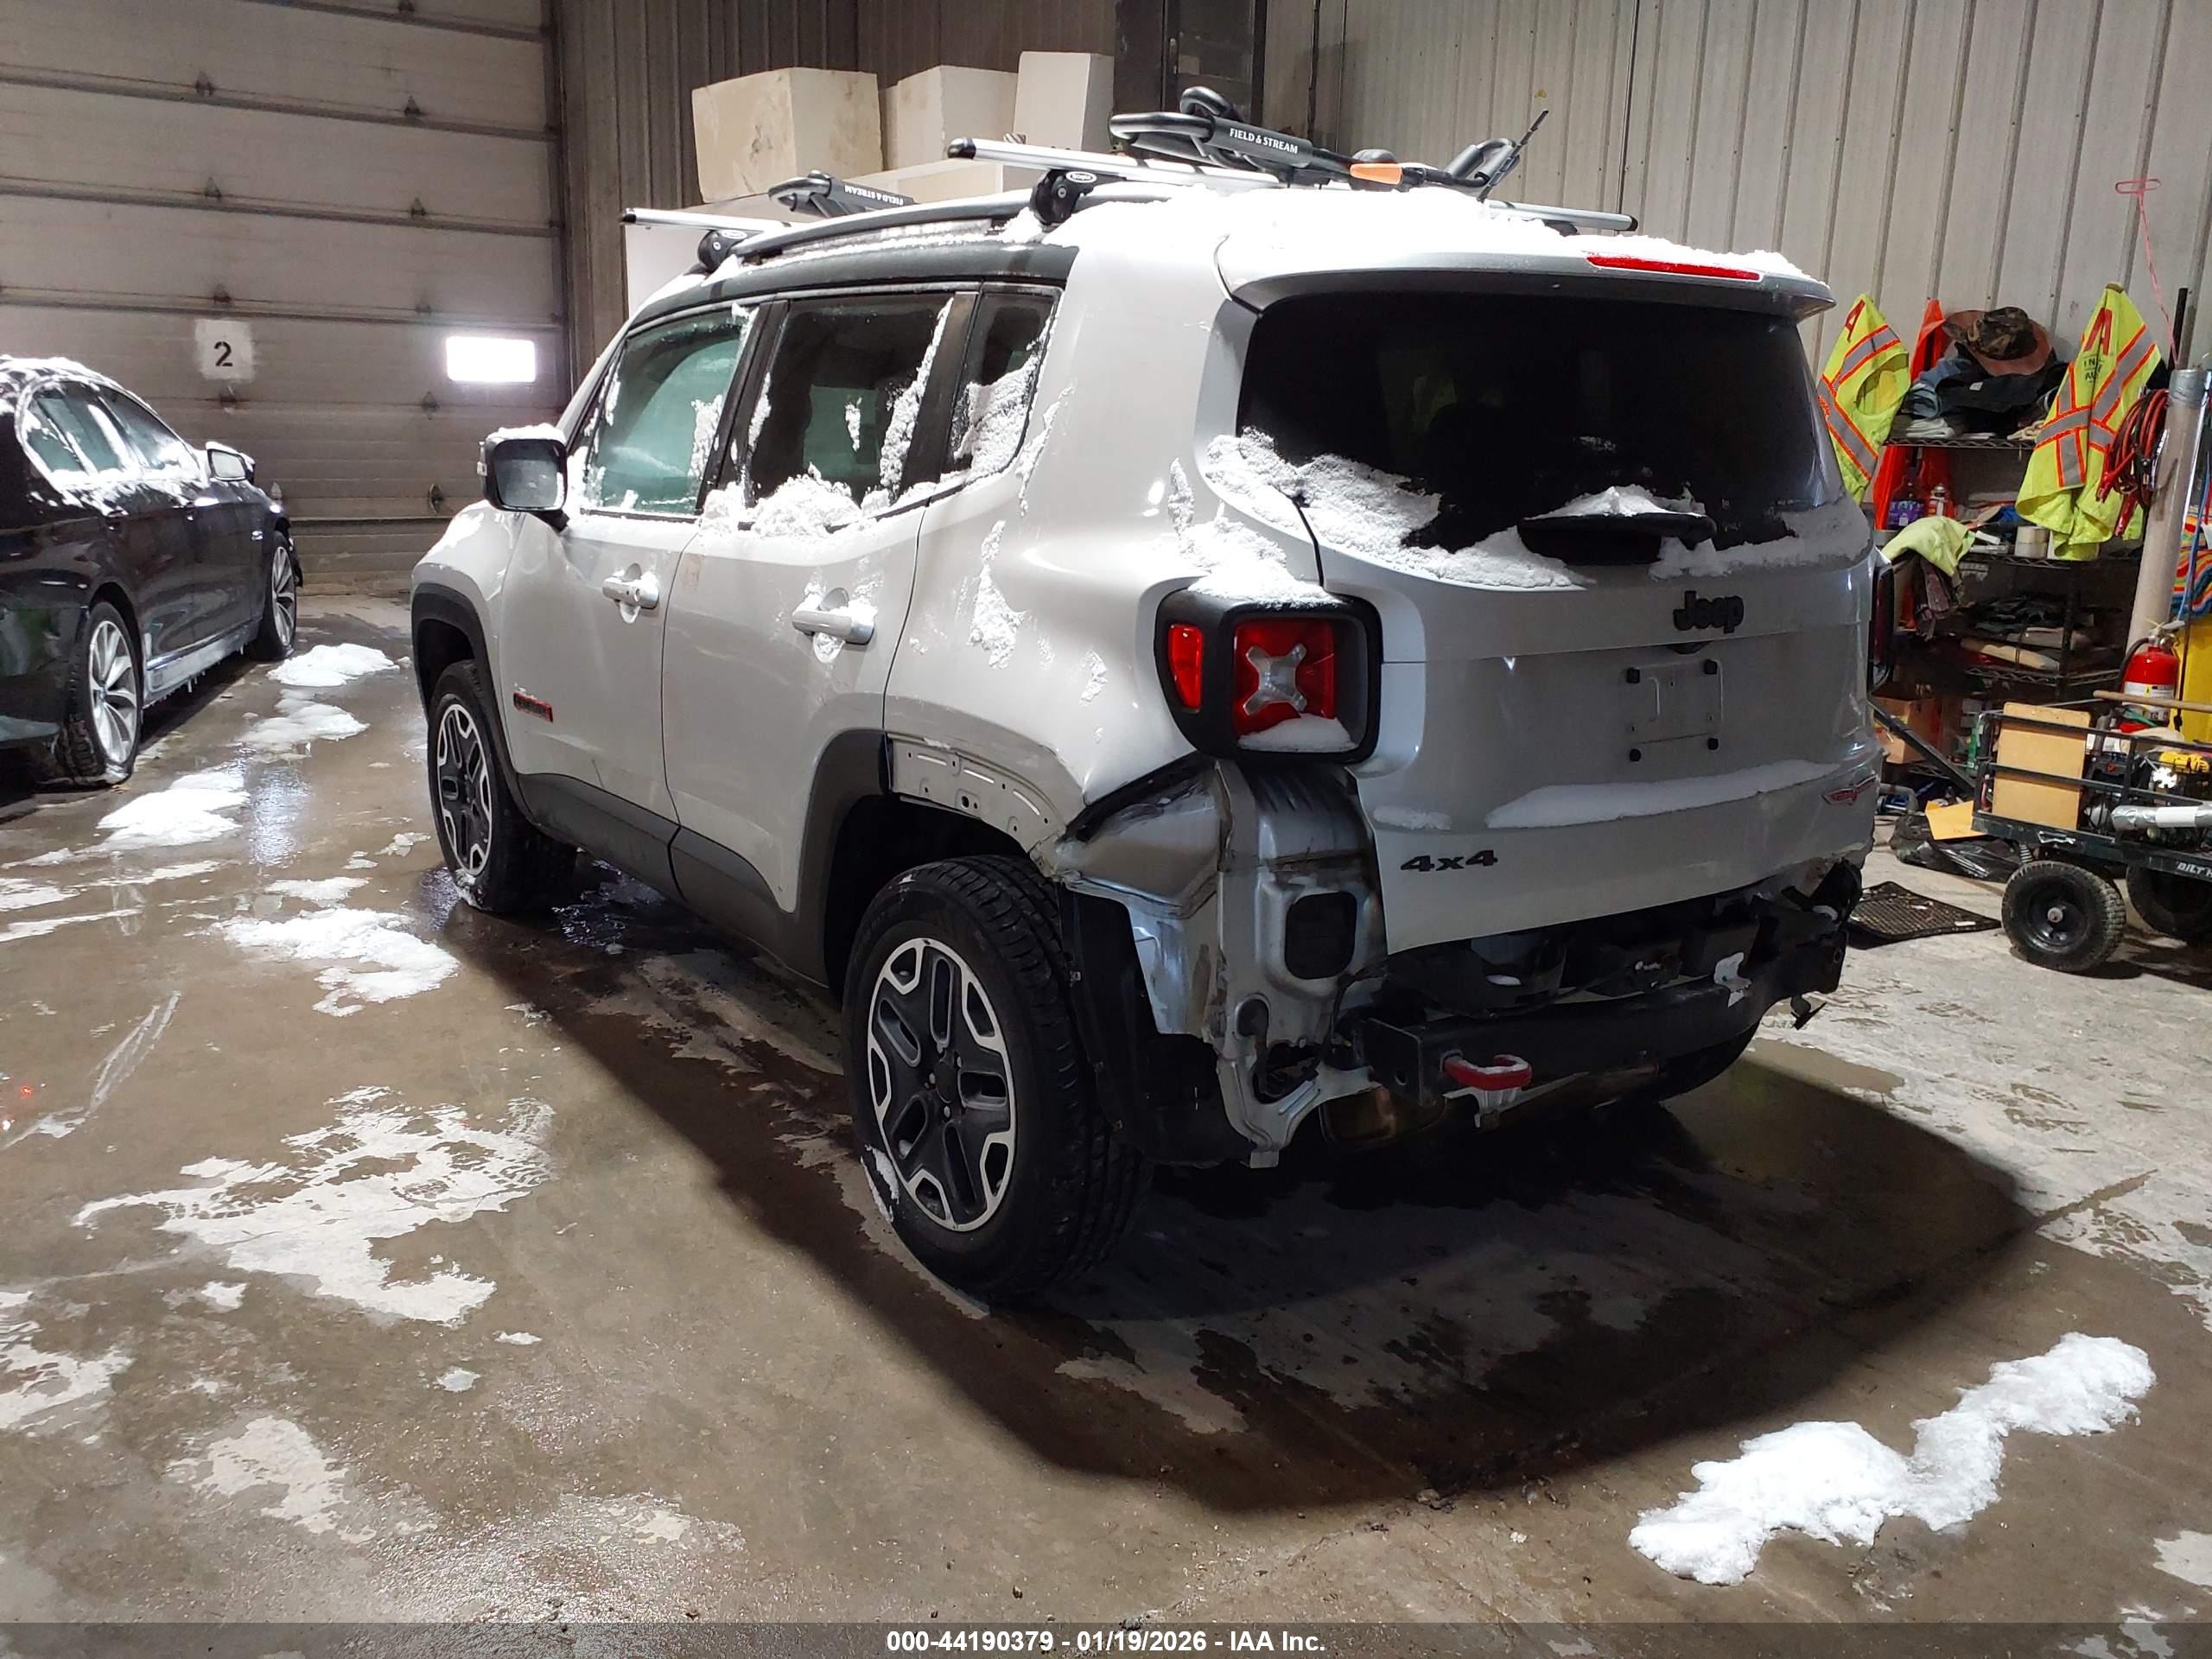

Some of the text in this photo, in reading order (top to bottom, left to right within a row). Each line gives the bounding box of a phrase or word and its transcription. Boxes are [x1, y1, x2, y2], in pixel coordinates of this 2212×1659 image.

[1230, 127, 1299, 155] FIELD & STREAM
[844, 184, 876, 199] STREAM
[882, 194, 904, 206] FIELD
[2082, 307, 2113, 356] A
[214, 340, 233, 367] 2
[1672, 589, 1745, 635] Jeep
[1400, 849, 1499, 873] 4x4
